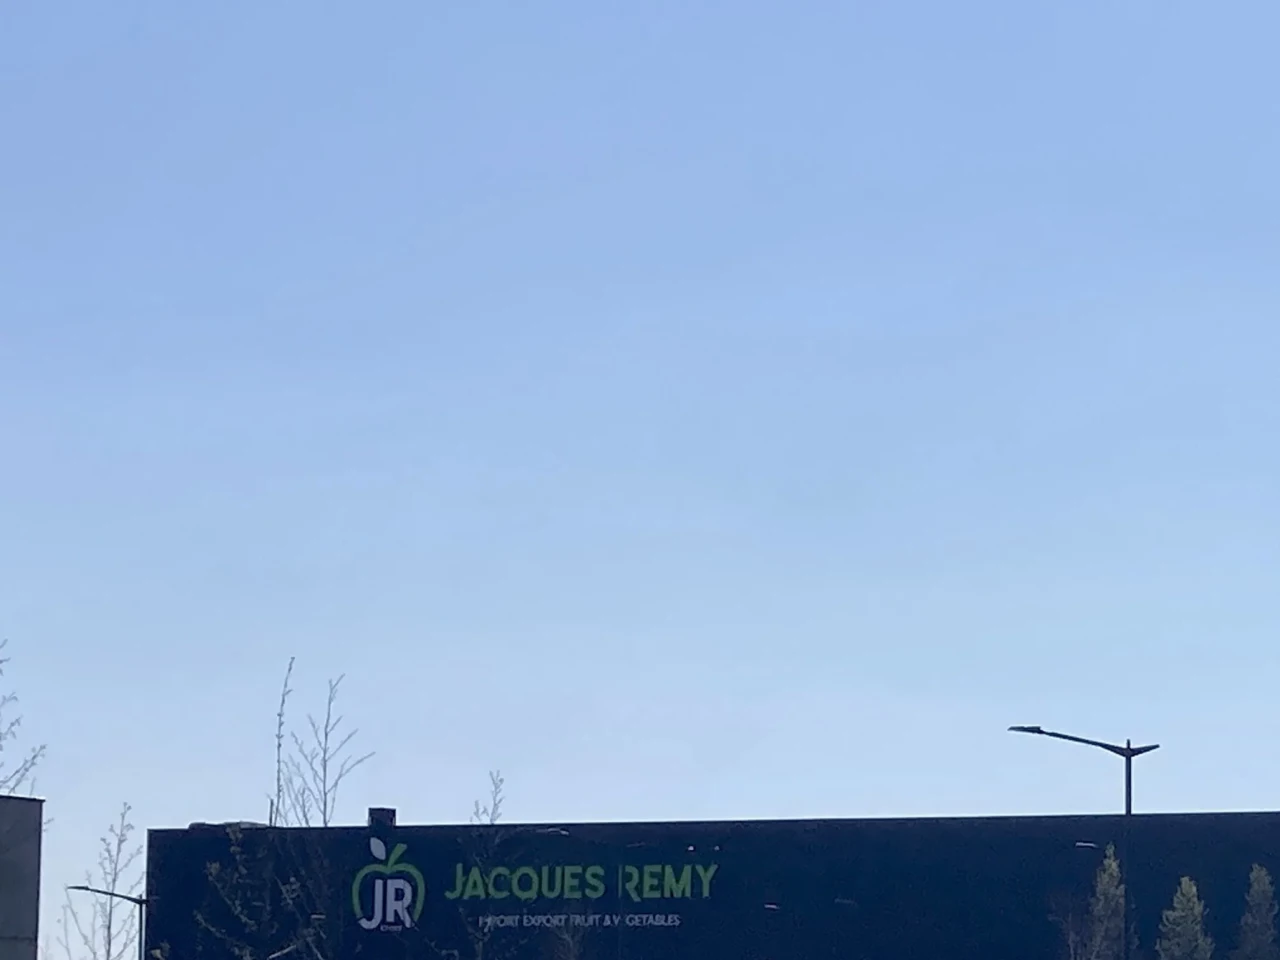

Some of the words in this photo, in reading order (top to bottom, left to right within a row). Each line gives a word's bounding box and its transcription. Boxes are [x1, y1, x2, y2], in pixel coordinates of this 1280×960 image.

[444, 862, 606, 901] JACQUES
[618, 863, 719, 902] REMY
[358, 878, 413, 930] JR
[522, 914, 569, 927] EXPORT
[569, 914, 602, 927] FRUIT
[612, 914, 682, 927] VGETABLES
